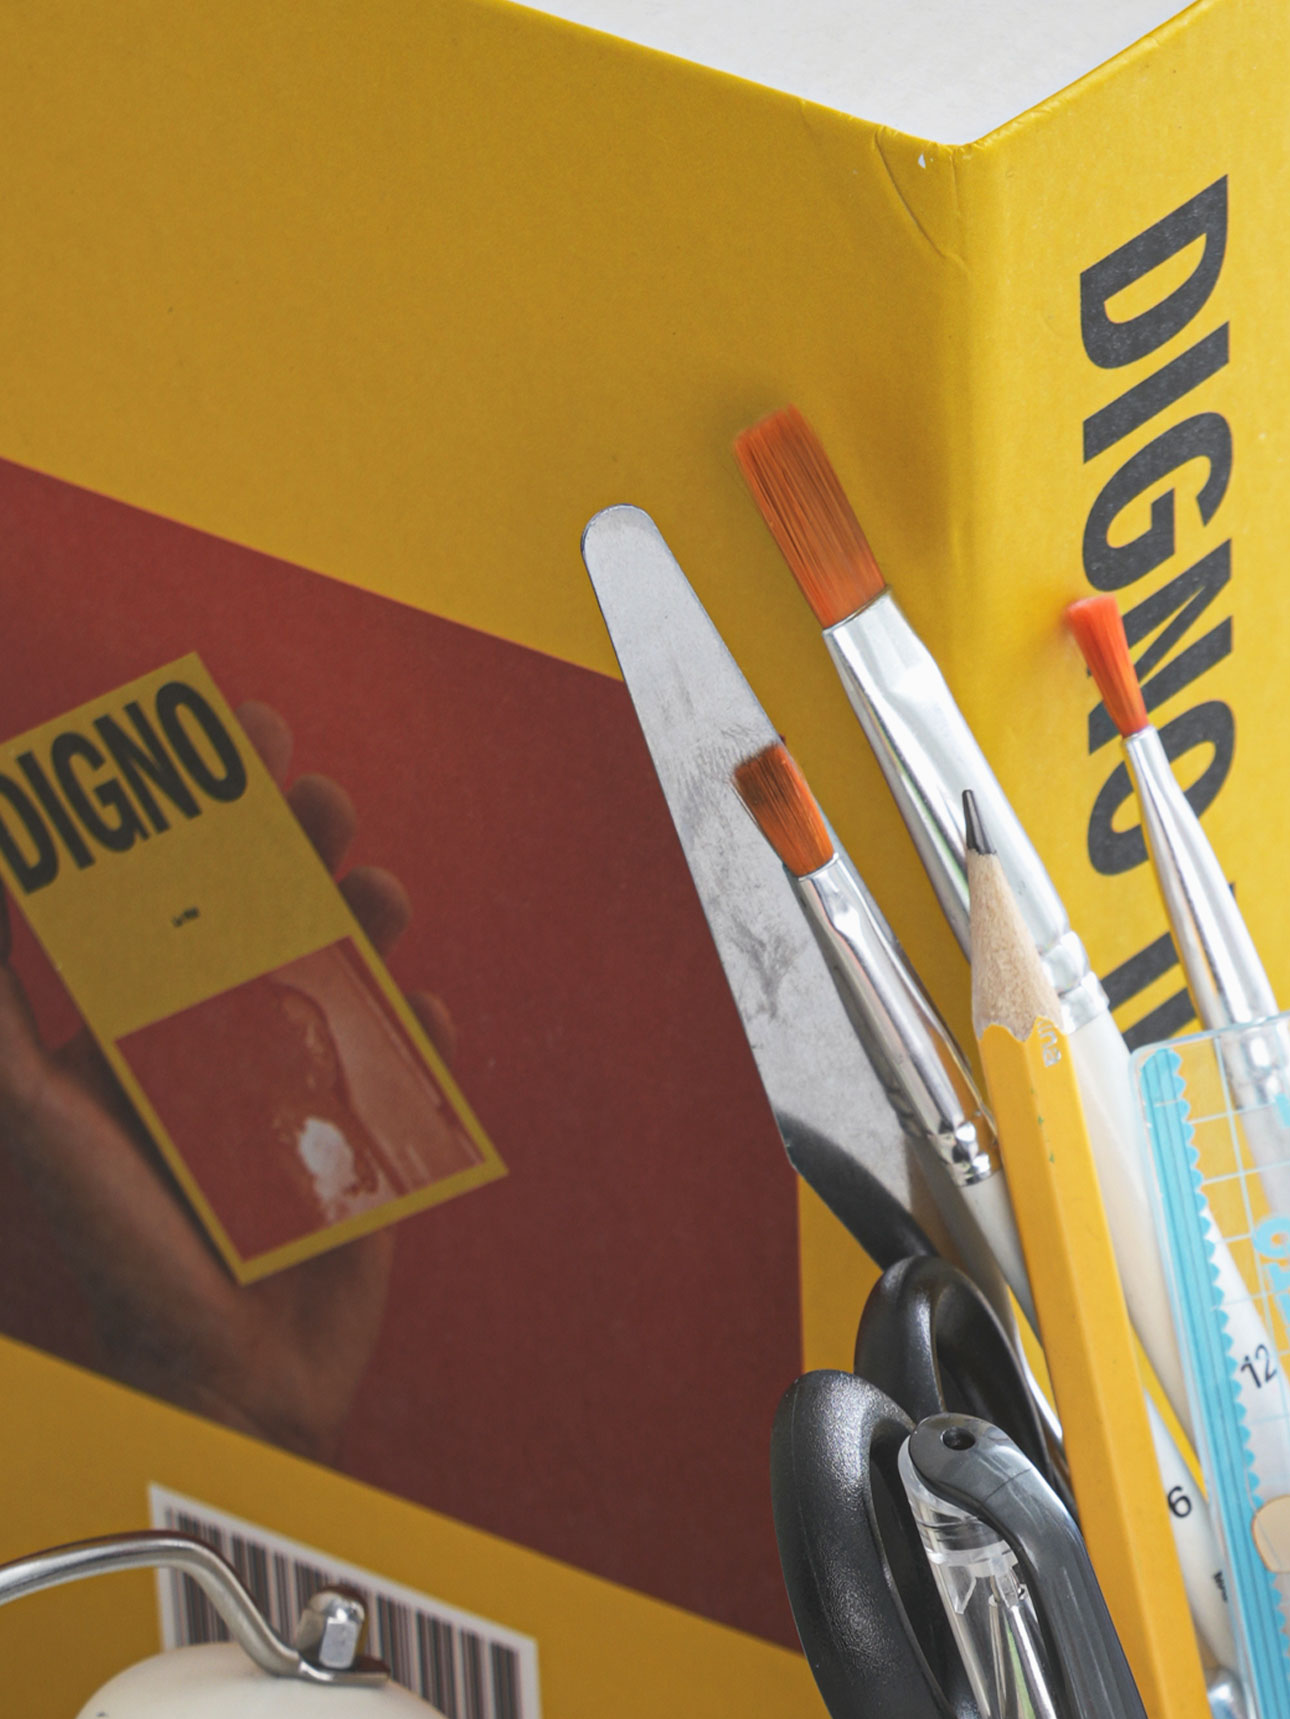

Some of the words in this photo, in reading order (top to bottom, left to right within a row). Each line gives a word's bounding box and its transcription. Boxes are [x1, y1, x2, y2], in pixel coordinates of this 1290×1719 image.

[1080, 174, 1236, 876] DIGNO
[0, 681, 247, 895] DIGNO
[1240, 1343, 1277, 1389] 12
[1167, 1485, 1192, 1518] 6
